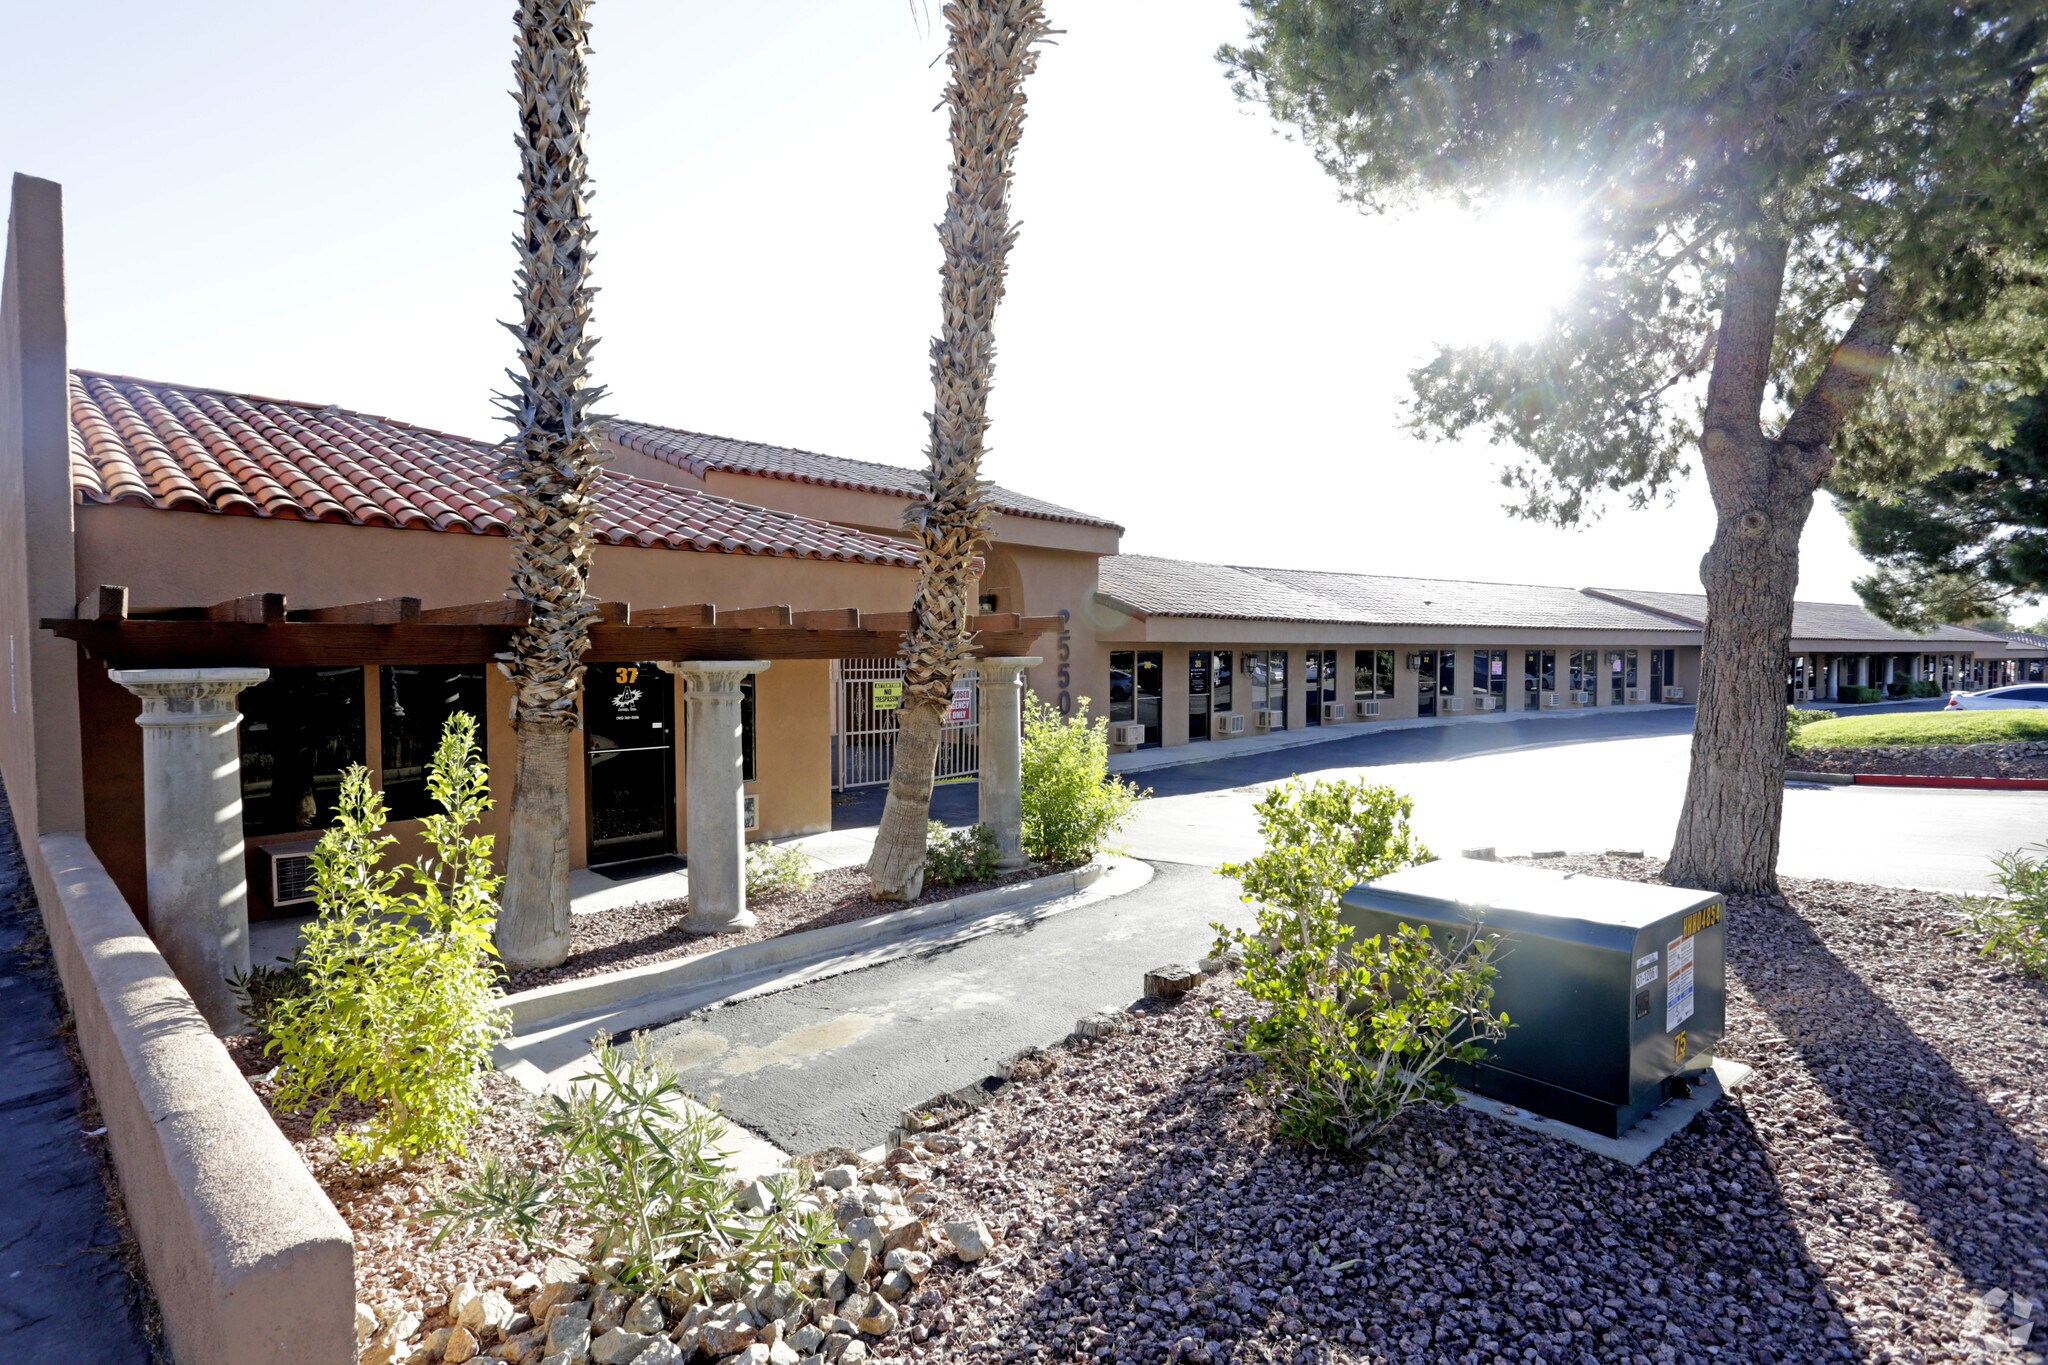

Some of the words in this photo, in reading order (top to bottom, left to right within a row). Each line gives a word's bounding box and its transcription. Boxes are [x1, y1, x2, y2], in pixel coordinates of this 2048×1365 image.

[616, 667, 638, 684] 37
[953, 690, 970, 699] LOSED
[951, 701, 969, 710] GENCY
[953, 711, 967, 719] ONLY
[1674, 1030, 1687, 1058] 75
